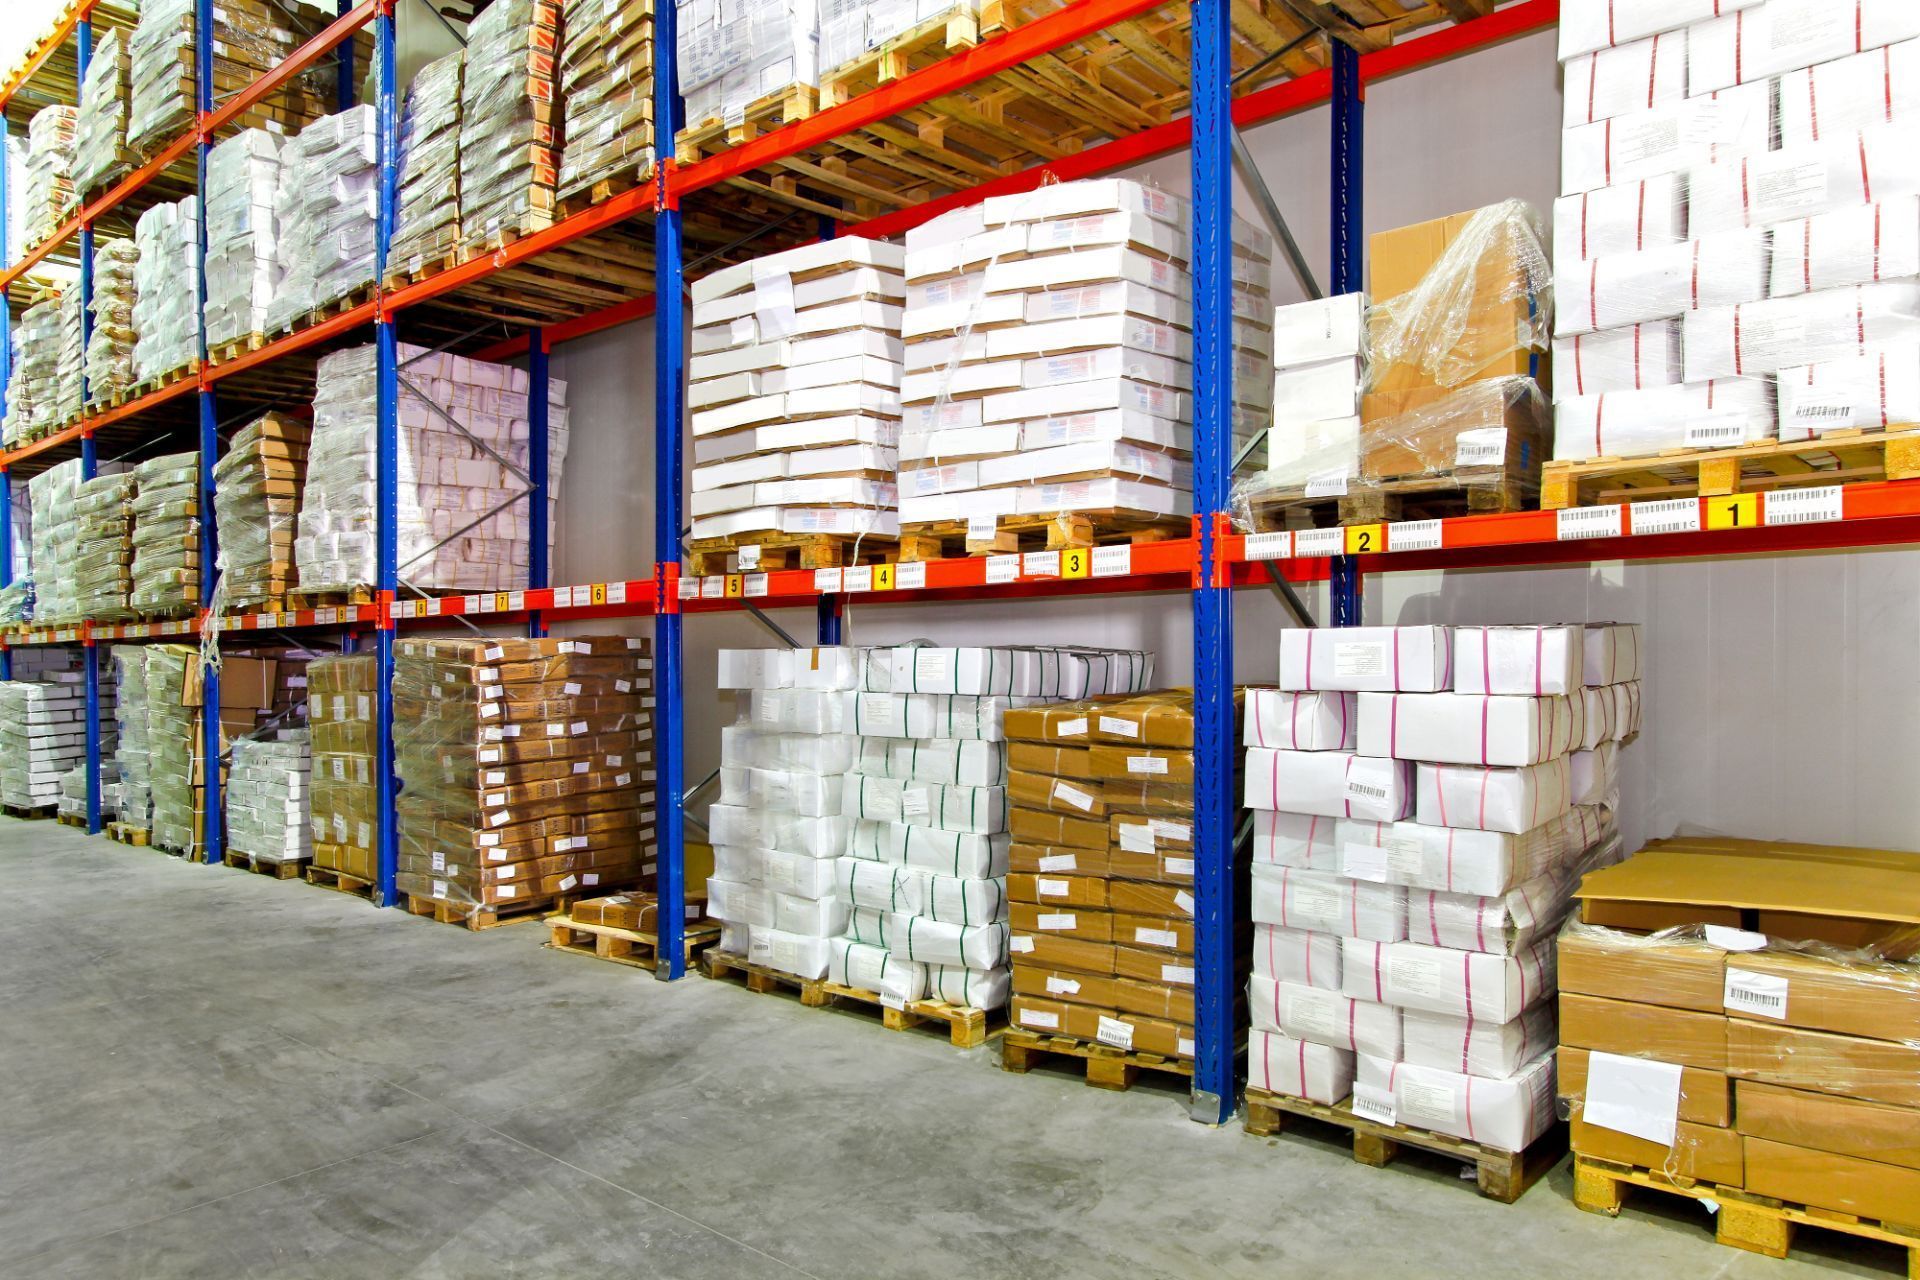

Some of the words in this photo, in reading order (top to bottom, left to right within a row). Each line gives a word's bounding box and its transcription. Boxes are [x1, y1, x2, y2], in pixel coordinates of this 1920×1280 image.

[1727, 503, 1739, 526] 1
[1358, 532, 1371, 552] 2
[1070, 555, 1080, 573] 3
[880, 570, 888, 585] 4
[731, 579, 738, 593] 5
[500, 596, 505, 608] 7
[596, 588, 602, 601] 6
